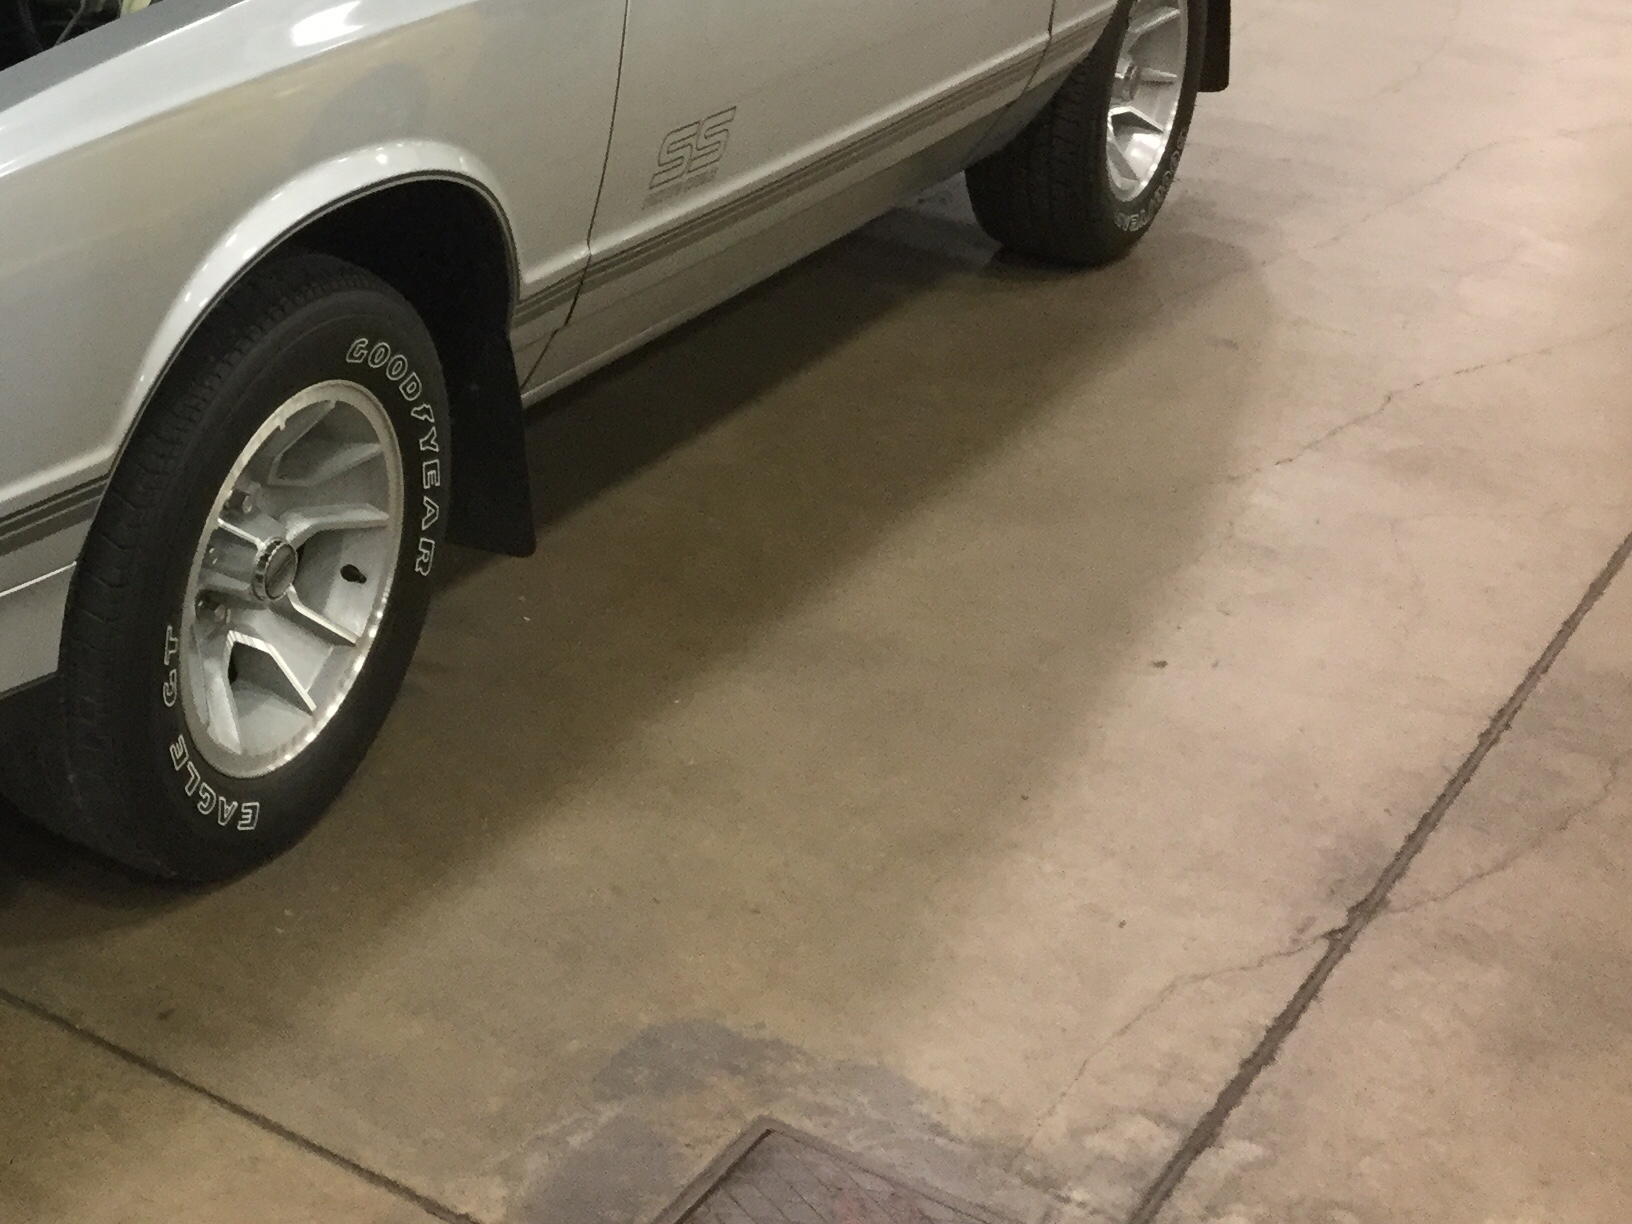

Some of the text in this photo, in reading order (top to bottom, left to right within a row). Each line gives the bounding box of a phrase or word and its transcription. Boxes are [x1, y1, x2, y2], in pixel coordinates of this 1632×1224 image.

[648, 105, 737, 190] SS
[346, 338, 441, 576] GOODYEAR
[163, 625, 261, 831] EAGLE GT
